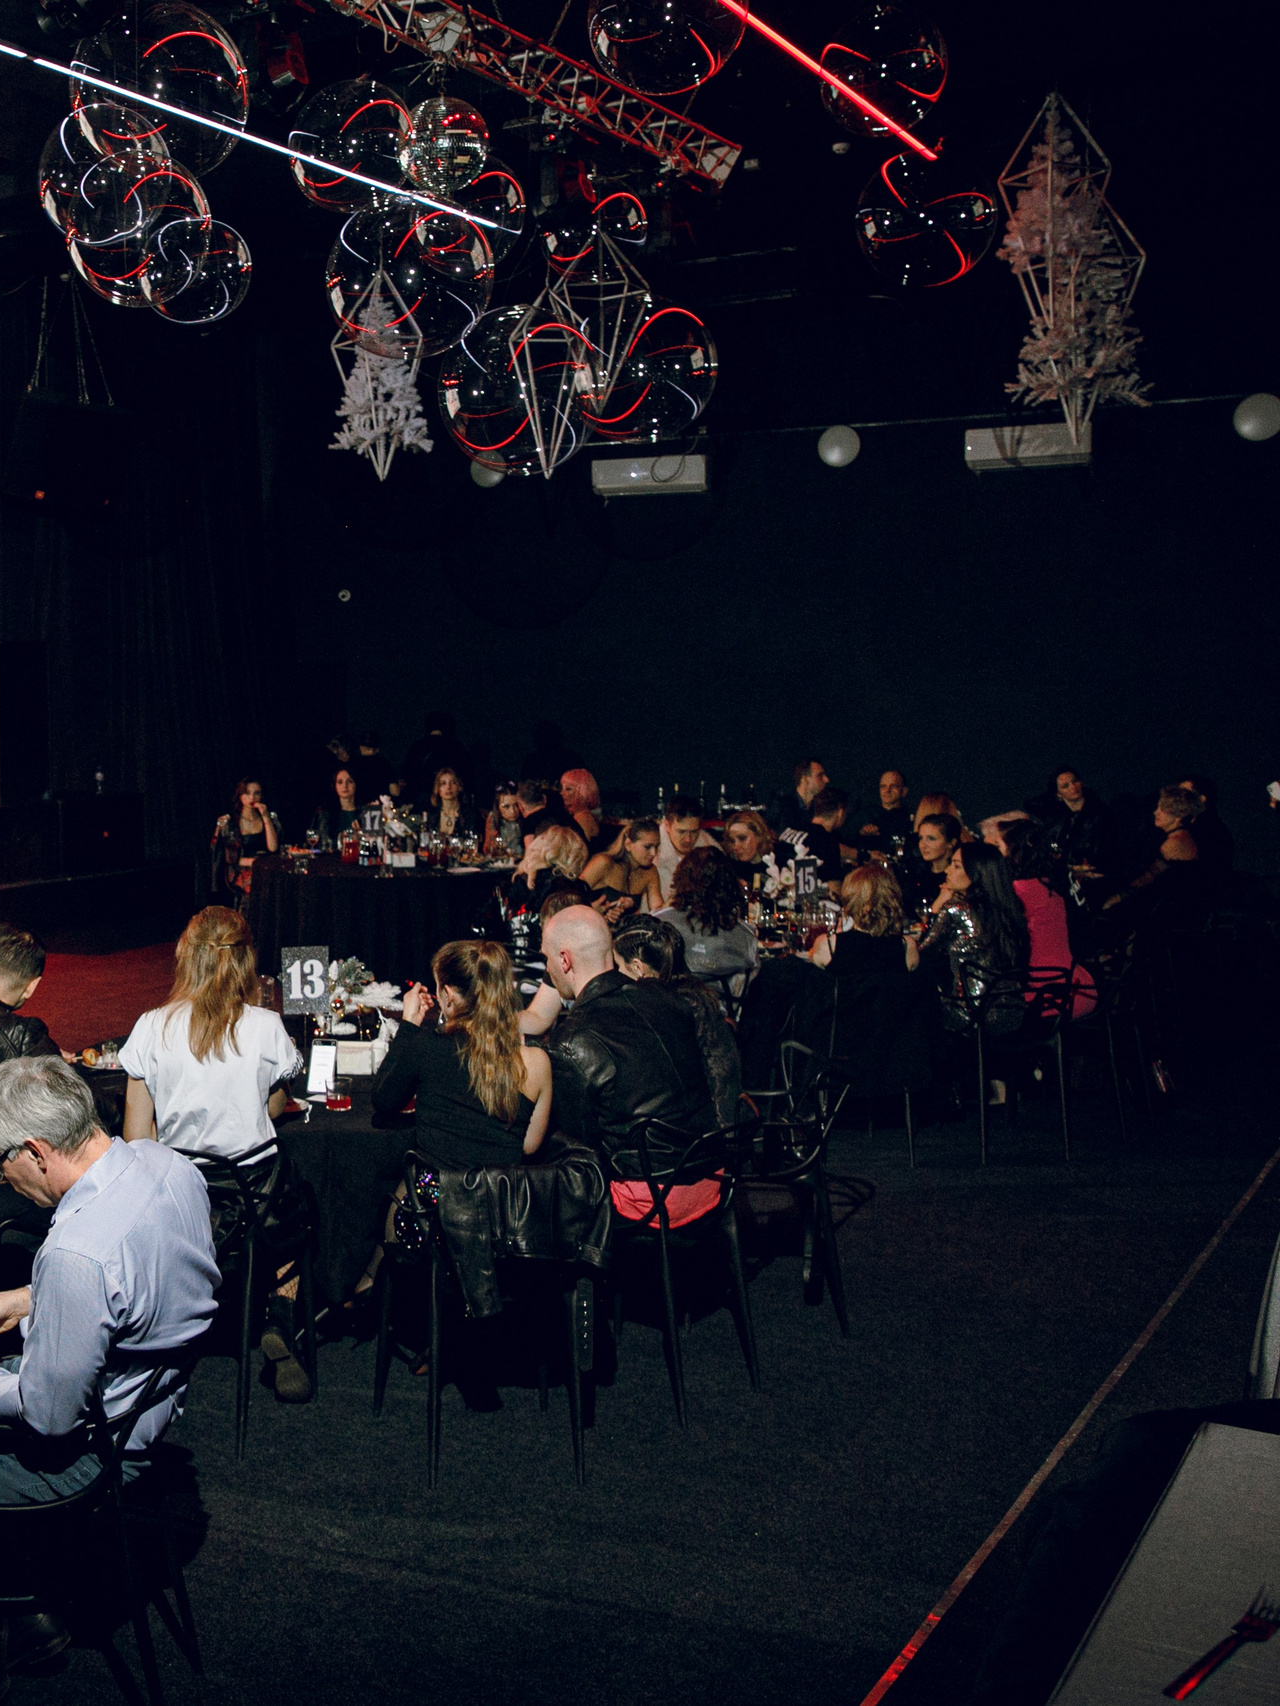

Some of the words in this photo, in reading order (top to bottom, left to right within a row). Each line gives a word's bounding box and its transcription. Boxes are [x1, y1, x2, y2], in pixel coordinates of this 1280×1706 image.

[364, 810, 381, 831] 17
[796, 865, 816, 894] 15
[286, 958, 325, 999] 13
